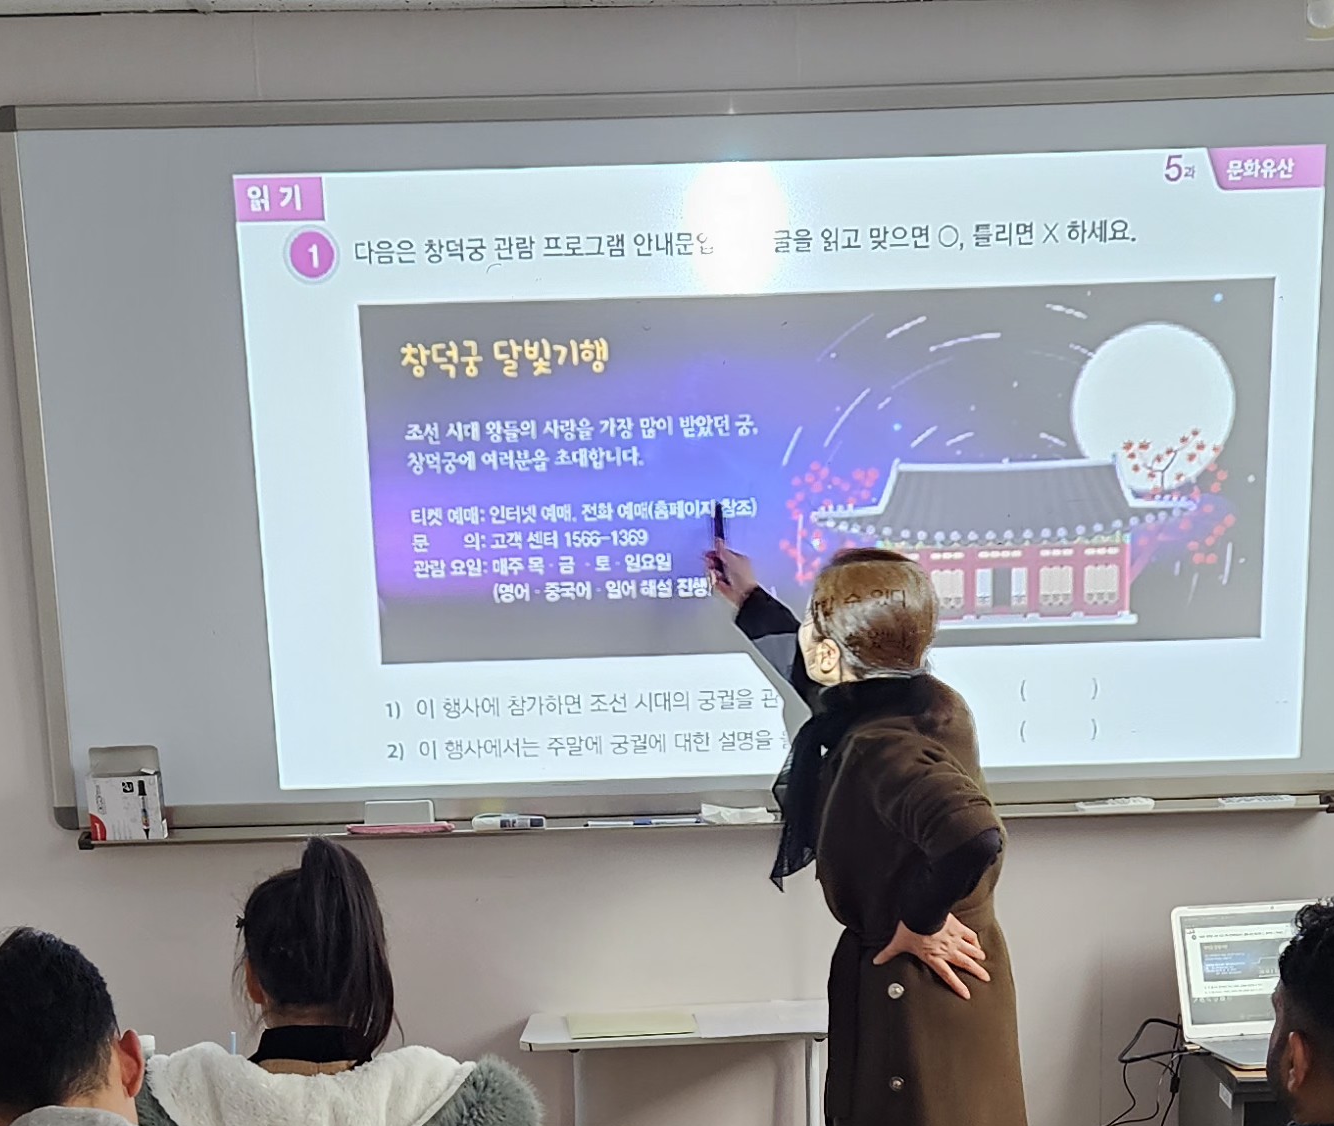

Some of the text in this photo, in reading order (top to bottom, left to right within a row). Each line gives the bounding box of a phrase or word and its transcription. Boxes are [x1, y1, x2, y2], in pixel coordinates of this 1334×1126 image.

[1226, 157, 1295, 181] 문화유산
[307, 243, 319, 269] 1
[354, 240, 417, 265] 다음은
[424, 237, 487, 263] 창덕궁
[493, 235, 535, 260] 관람
[543, 233, 625, 257] 프로그램
[773, 228, 813, 254] 글을
[820, 227, 862, 252] 읽고
[869, 225, 930, 250] 맞으면
[972, 221, 1035, 248] 틀리면
[1066, 219, 1137, 244] 하세요.
[400, 337, 609, 379] 창덕궁 달빛기행
[404, 422, 441, 445] 조선
[445, 421, 481, 442] 시대
[485, 419, 537, 443] 왕들의
[542, 417, 595, 441] 사랑을
[599, 416, 635, 440] 가장
[639, 415, 674, 439] 많이
[679, 414, 731, 438] 받았던
[407, 446, 645, 476] 창덕궁에 여러분을 초대합니다.
[410, 507, 443, 526] 티켓
[489, 504, 537, 525] 인터넷
[581, 501, 614, 522] 전화
[490, 531, 523, 549] 고객
[527, 529, 559, 550] 센터
[492, 556, 525, 576] 매주
[558, 555, 575, 575] 금
[594, 555, 612, 572] 토
[624, 552, 672, 573] 일요일
[543, 579, 593, 602] 중국어
[385, 700, 401, 719] 1)
[417, 698, 435, 719] 이
[442, 696, 501, 719] 행사에
[507, 694, 582, 717] 참가하면
[590, 692, 627, 713] 조선
[634, 690, 690, 712] 시대의
[697, 688, 754, 711] 궁궐을
[387, 742, 404, 760] 2)
[419, 740, 437, 760] 이
[444, 737, 540, 761] 행사에서는
[547, 734, 602, 757] 주말에
[610, 733, 666, 755] 궁궐에
[674, 731, 710, 753] 대한
[718, 729, 774, 751] 설명을
